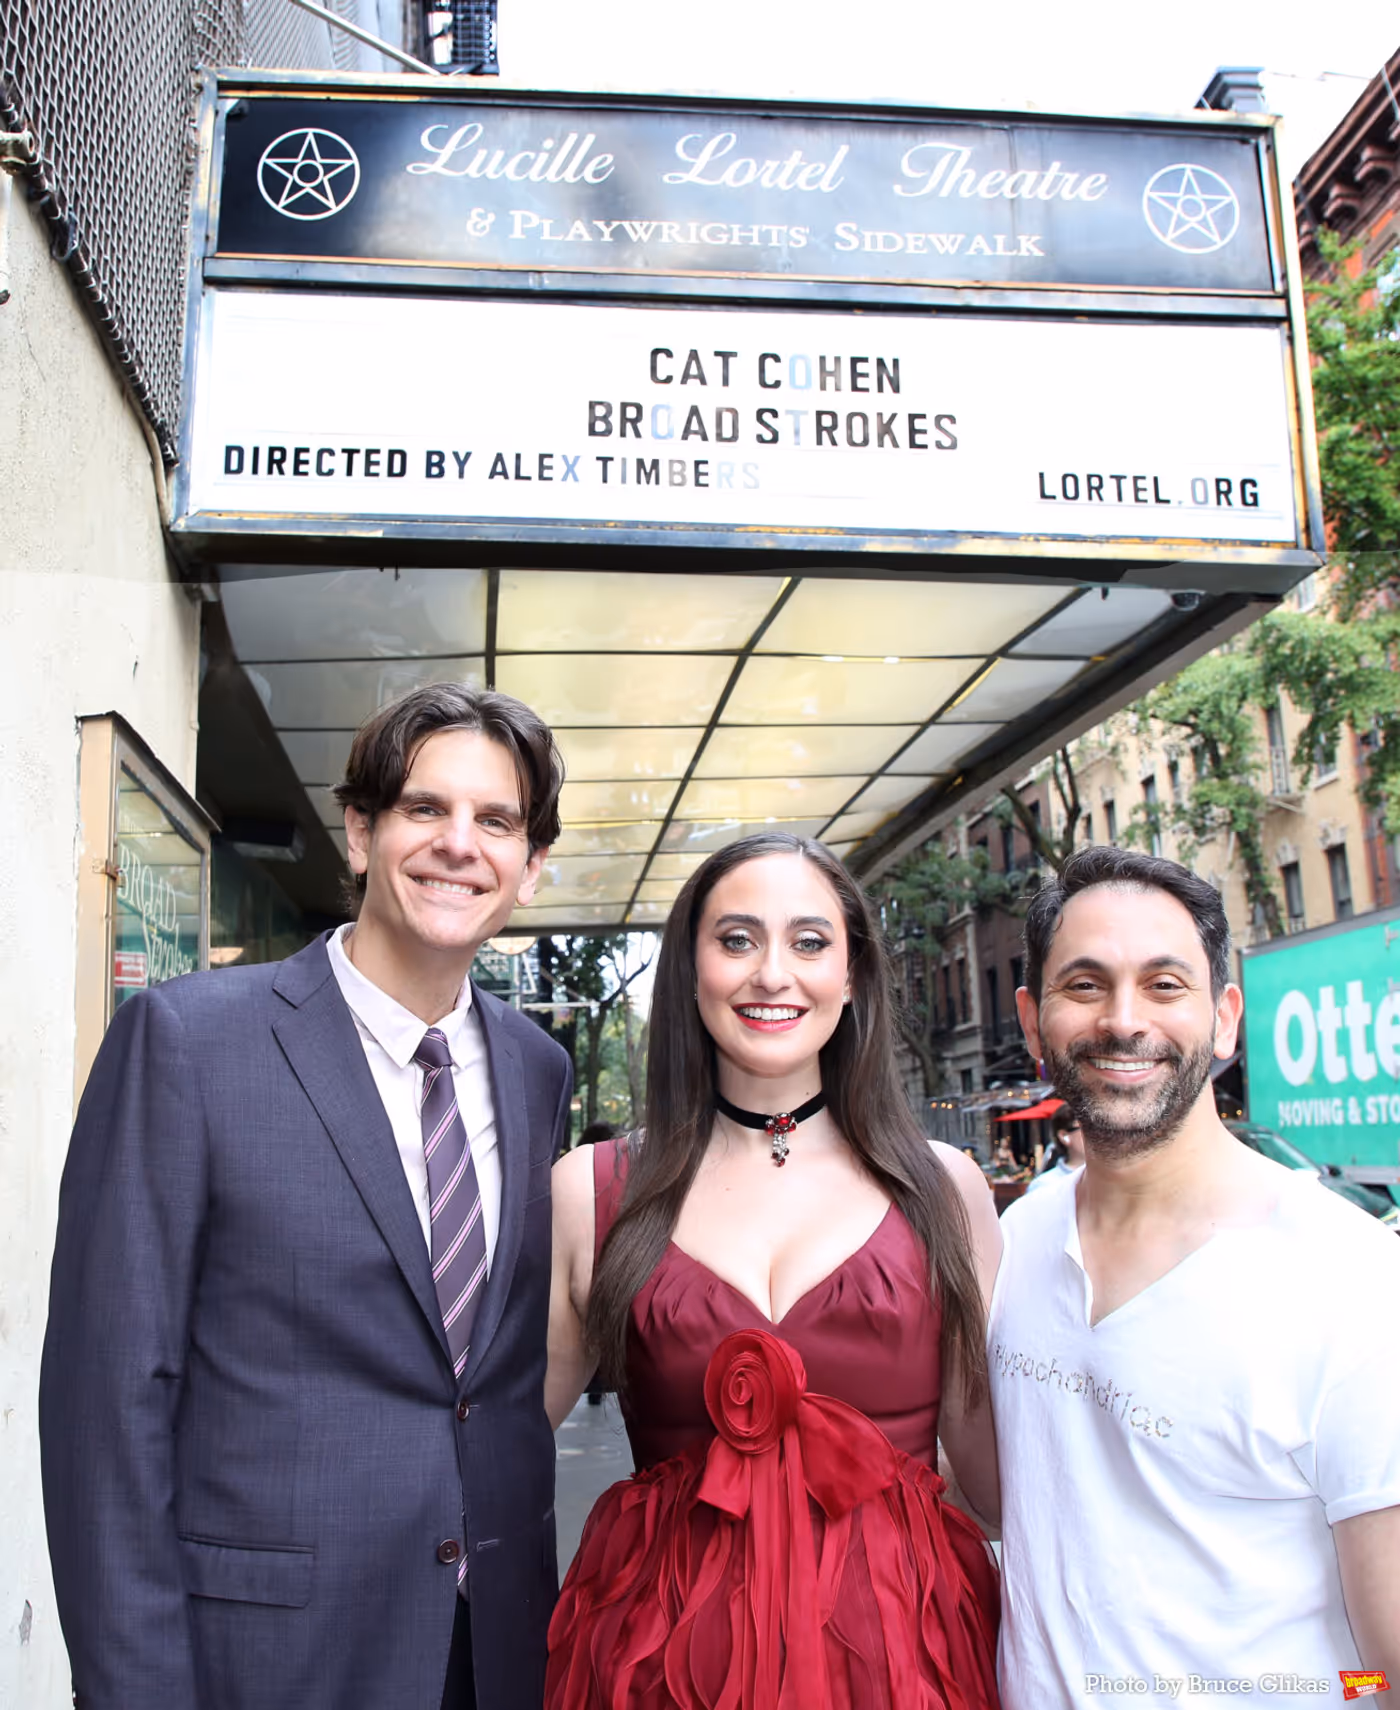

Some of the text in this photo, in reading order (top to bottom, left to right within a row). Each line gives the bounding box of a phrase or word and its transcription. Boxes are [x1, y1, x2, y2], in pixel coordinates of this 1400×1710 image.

[405, 122, 1109, 202] Lucille Lortel Theatre
[466, 207, 496, 238] &
[834, 222, 1045, 258] SIDEWALK
[649, 347, 902, 394] CAT COHEN
[588, 400, 958, 449] BROAD STROKES
[223, 445, 761, 489] DIRECTED BY ALEX TIMBERS
[1038, 471, 1260, 508] LORTEL.ORG
[1278, 1098, 1345, 1127] MOVING
[1347, 1096, 1362, 1125] &
